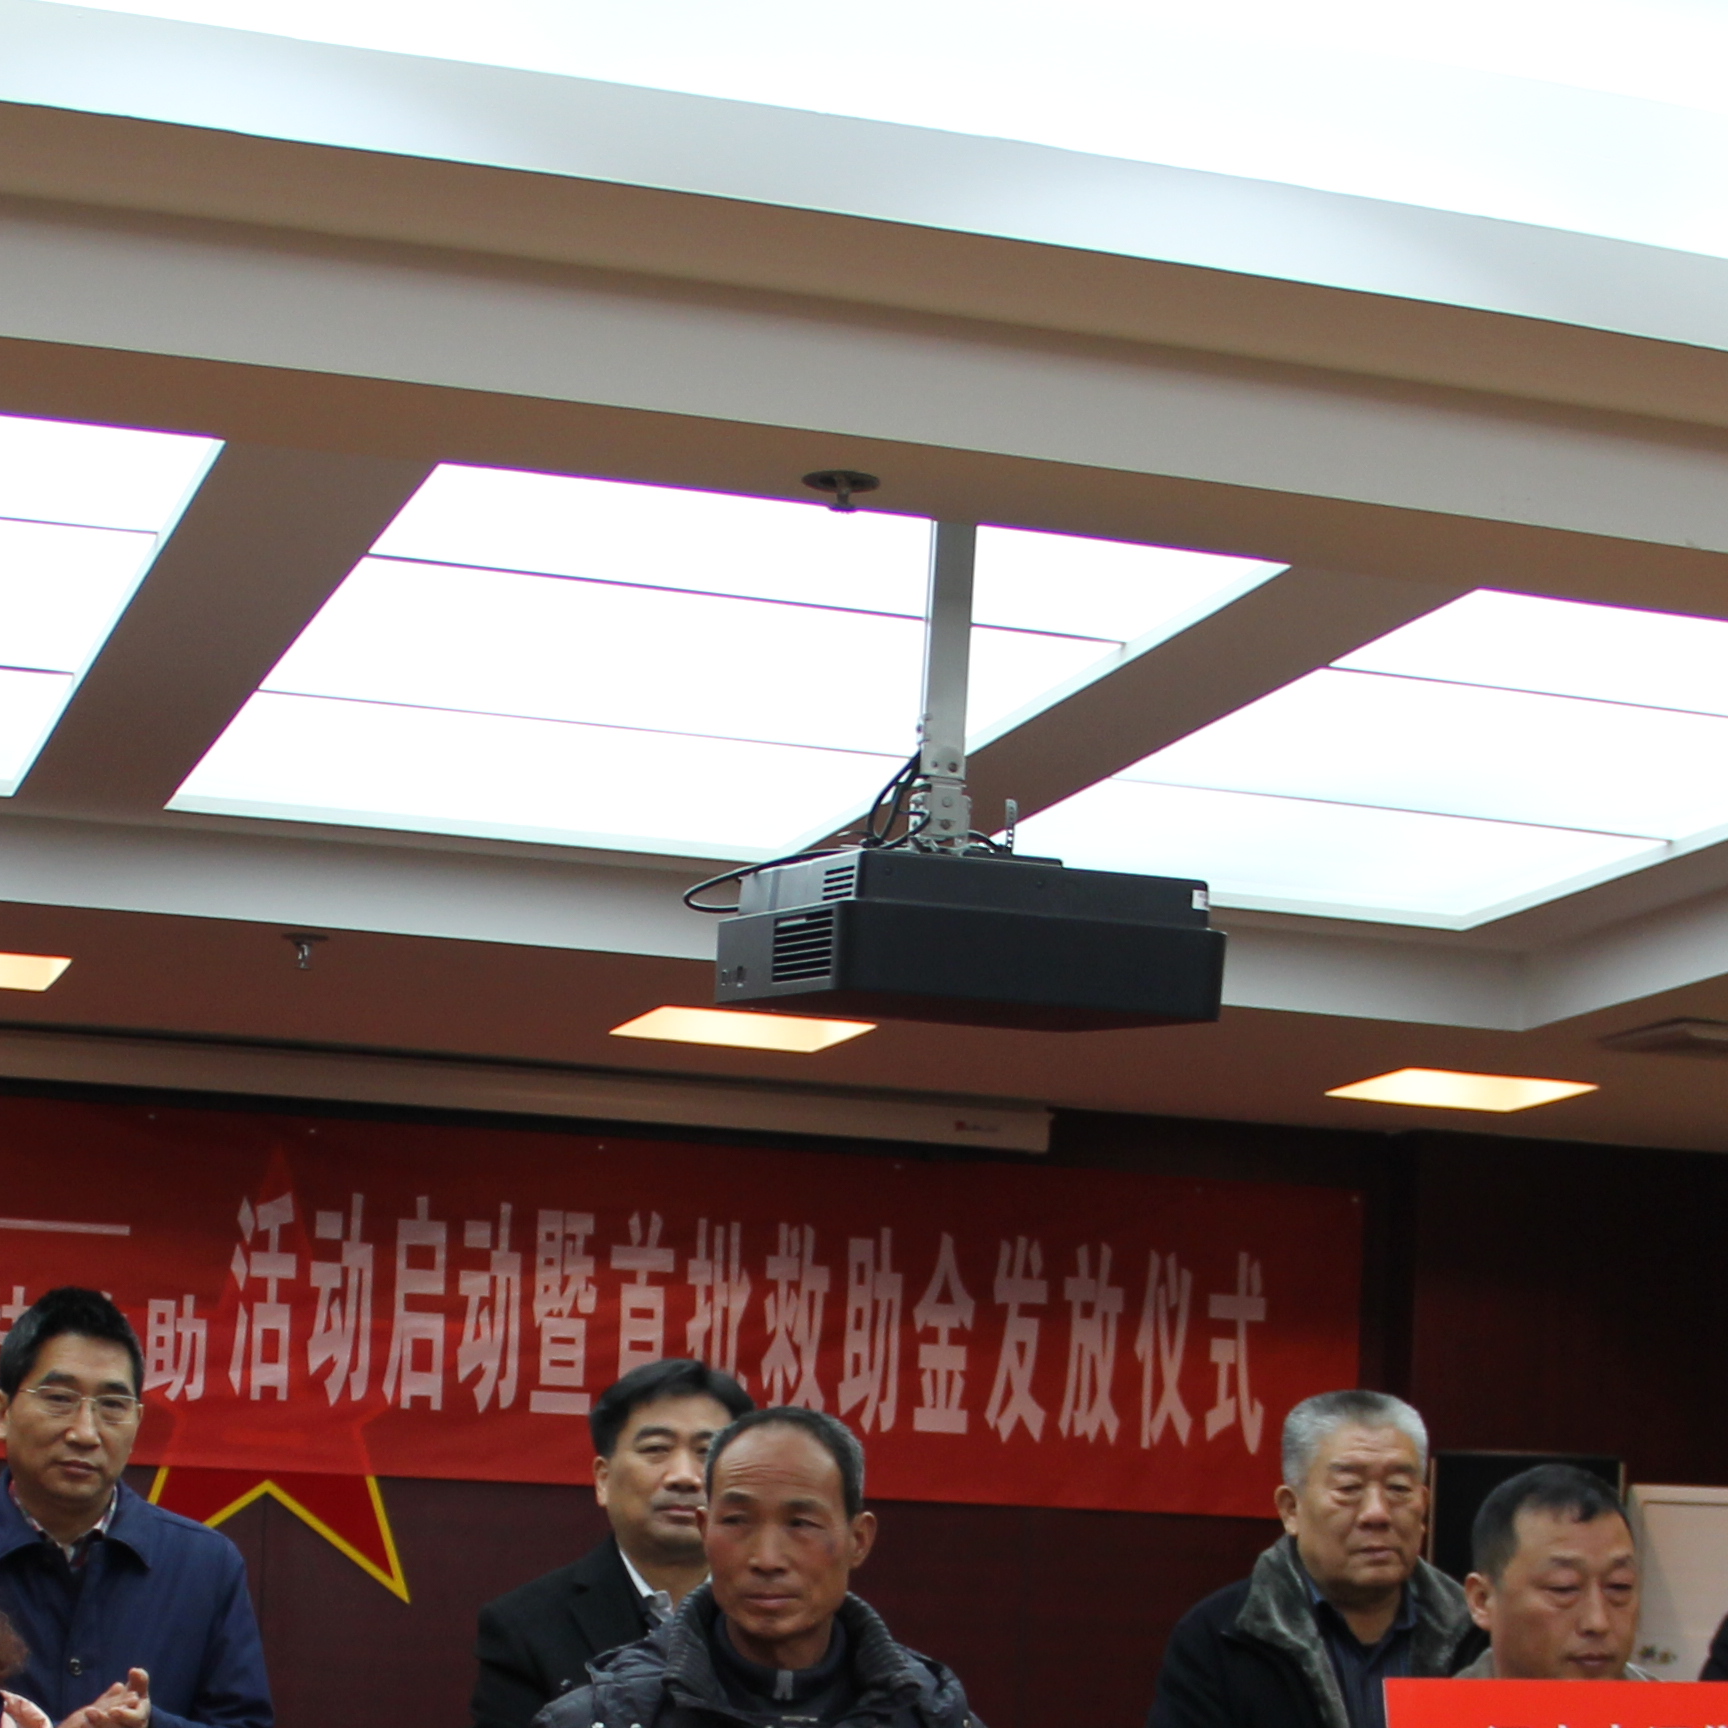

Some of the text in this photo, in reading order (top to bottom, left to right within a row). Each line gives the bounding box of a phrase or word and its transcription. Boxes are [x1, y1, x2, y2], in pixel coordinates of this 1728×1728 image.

[228, 1192, 1267, 1455] 活动启动暨首批救助金发放仪式
